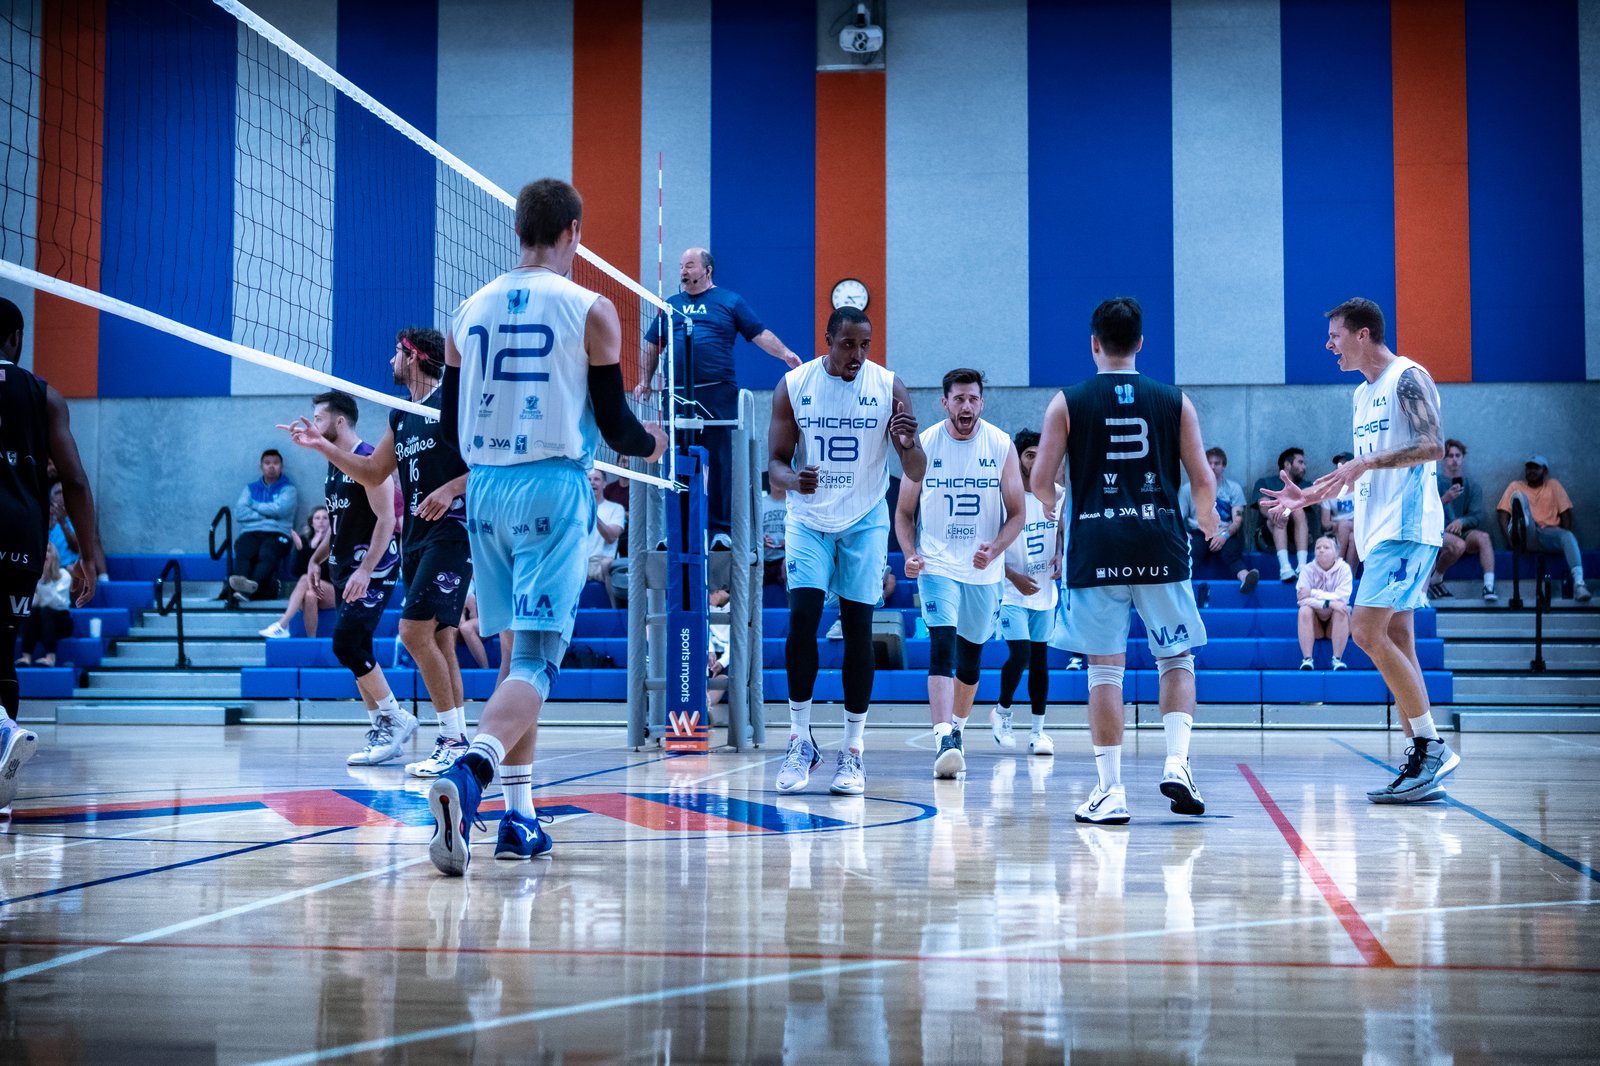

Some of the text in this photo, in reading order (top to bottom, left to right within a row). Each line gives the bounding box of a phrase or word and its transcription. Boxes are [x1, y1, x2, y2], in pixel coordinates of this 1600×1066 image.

[682, 304, 707, 315] VLA
[468, 324, 554, 382] 12
[858, 396, 878, 406] VLA
[797, 417, 878, 429] CHICAGO
[395, 437, 437, 462] Bounce
[814, 435, 859, 462] 18
[1105, 417, 1149, 460] 3
[409, 458, 420, 483] 16
[979, 458, 997, 468] VLA
[820, 475, 852, 484] KEHOE
[925, 478, 1000, 489] CHICAGO
[944, 493, 980, 517] 13
[1026, 534, 1045, 556] 5
[1108, 565, 1169, 577] NOVUS
[513, 593, 554, 618] VLA
[1150, 624, 1189, 646] VLA
[680, 628, 690, 703] sports imports
